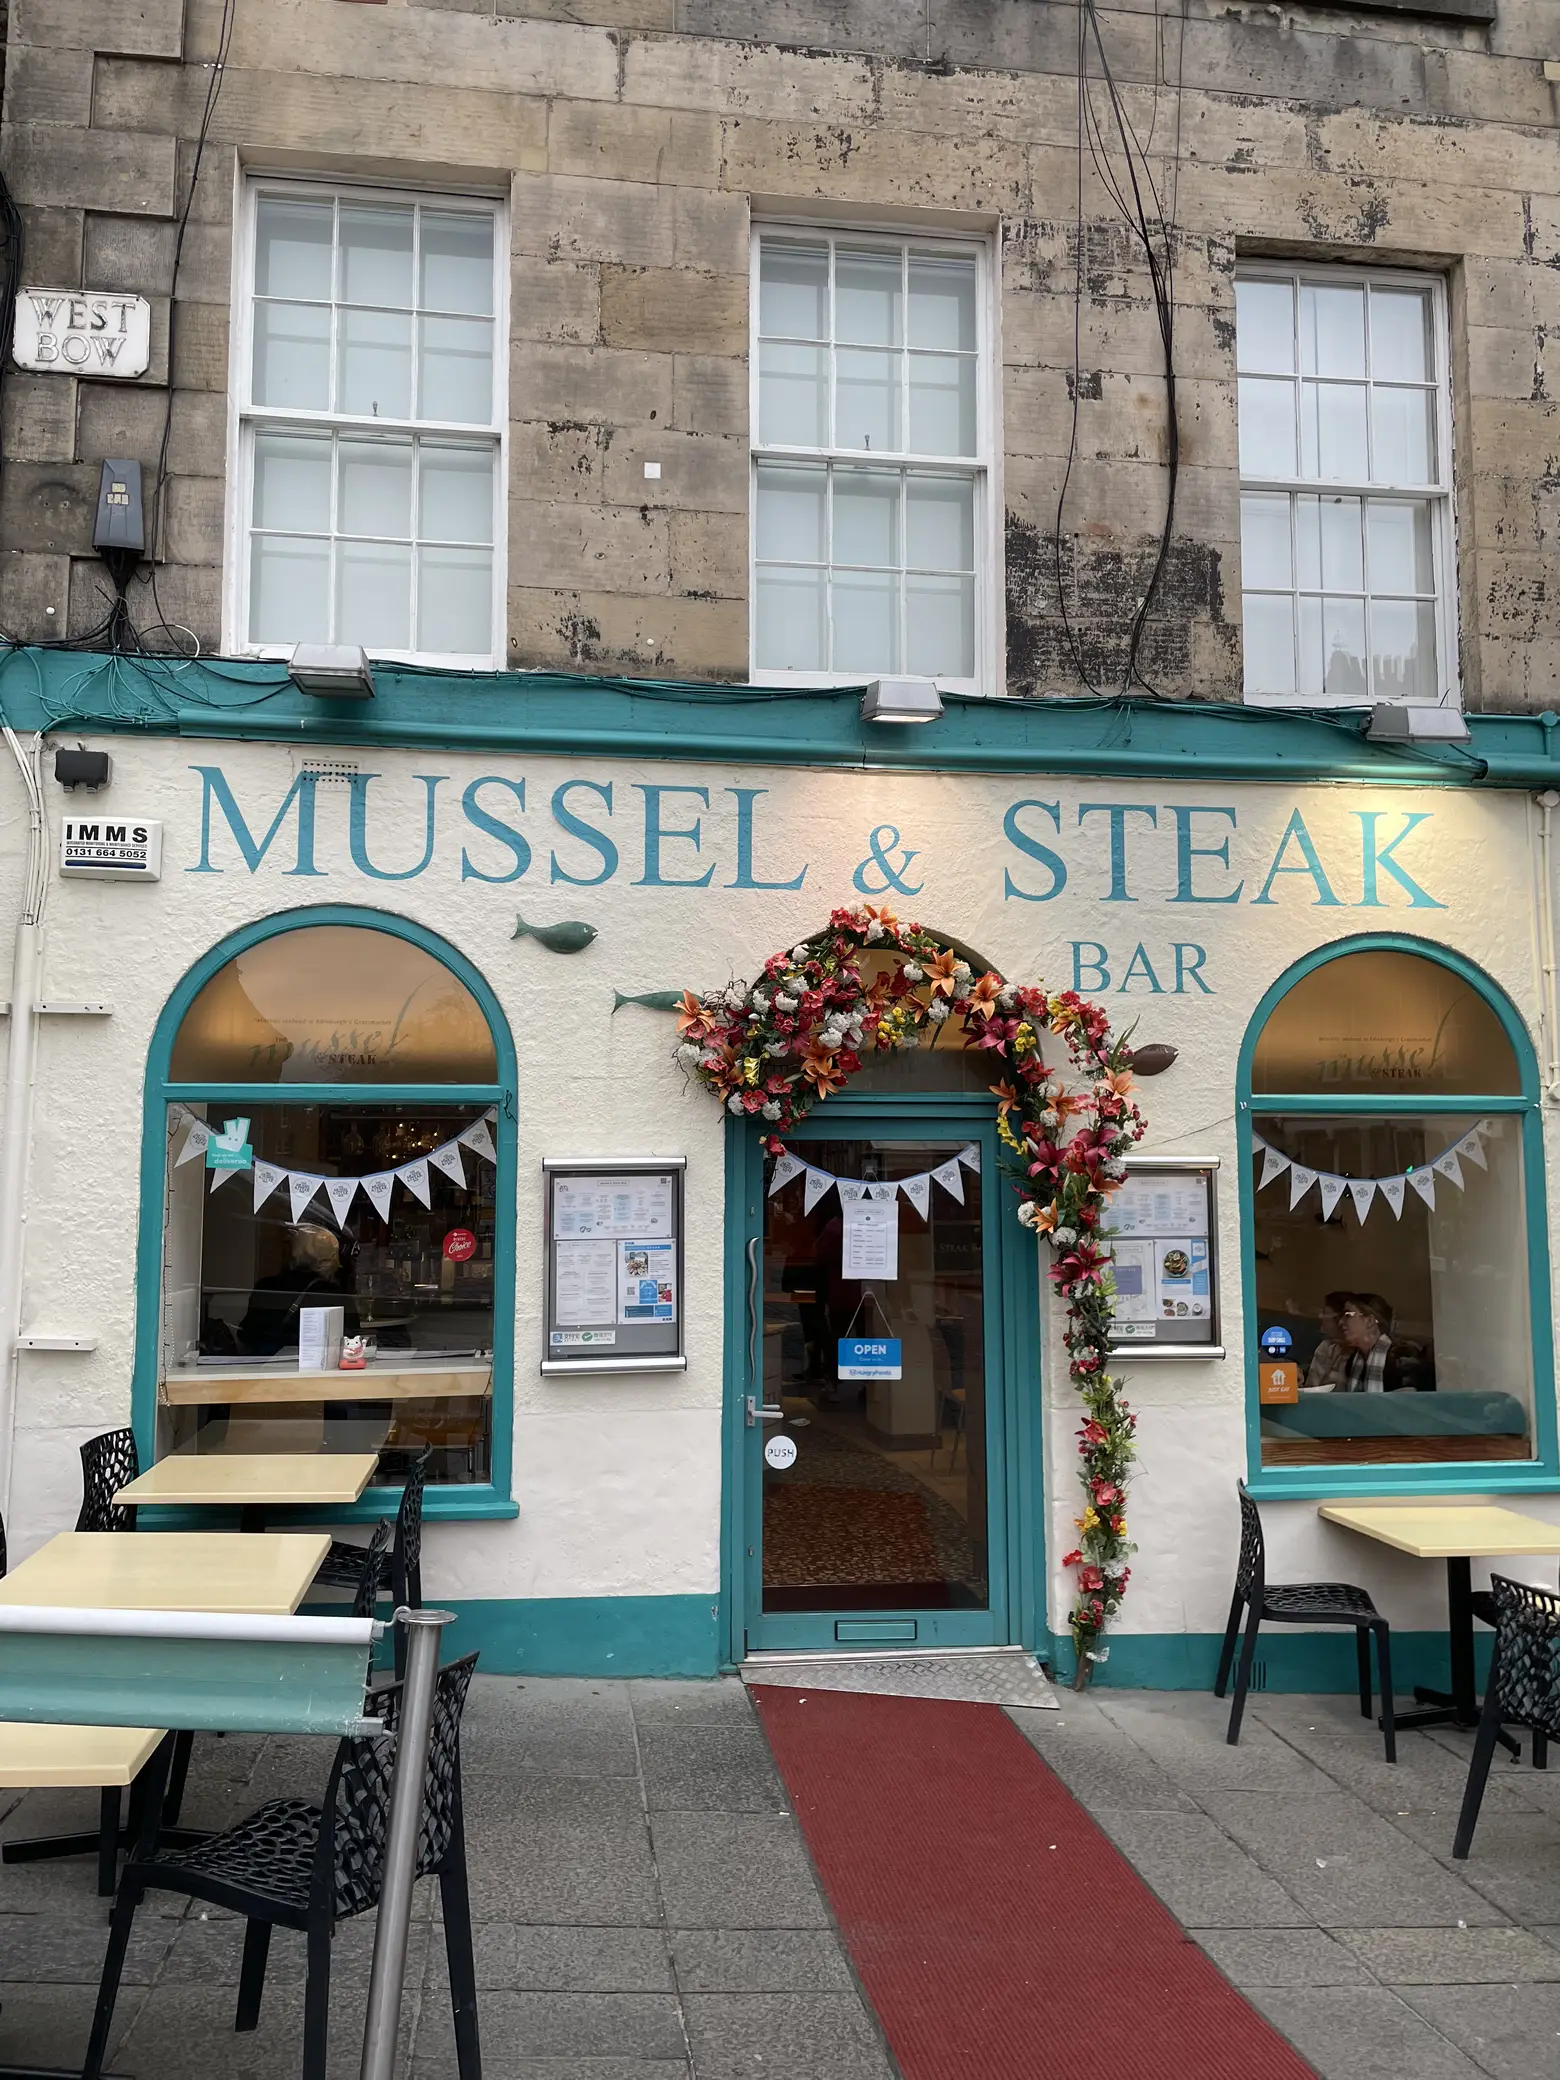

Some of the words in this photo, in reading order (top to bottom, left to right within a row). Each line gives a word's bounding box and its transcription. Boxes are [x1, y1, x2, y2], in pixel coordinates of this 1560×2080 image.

[28, 296, 136, 333] WEST
[35, 332, 127, 367] BOW
[66, 824, 148, 843] IMMS
[184, 765, 809, 889] MUSSEL
[852, 824, 925, 896] &
[1003, 799, 1448, 909] STEAK
[66, 848, 92, 856] 0131
[119, 850, 147, 858] 5052
[1066, 940, 1214, 994] BAR
[327, 1054, 377, 1065] STEAK
[1382, 1068, 1422, 1079] STEAK
[448, 1241, 471, 1254] Choice
[854, 1344, 887, 1355] OPEN
[767, 1448, 795, 1457] PUSH
